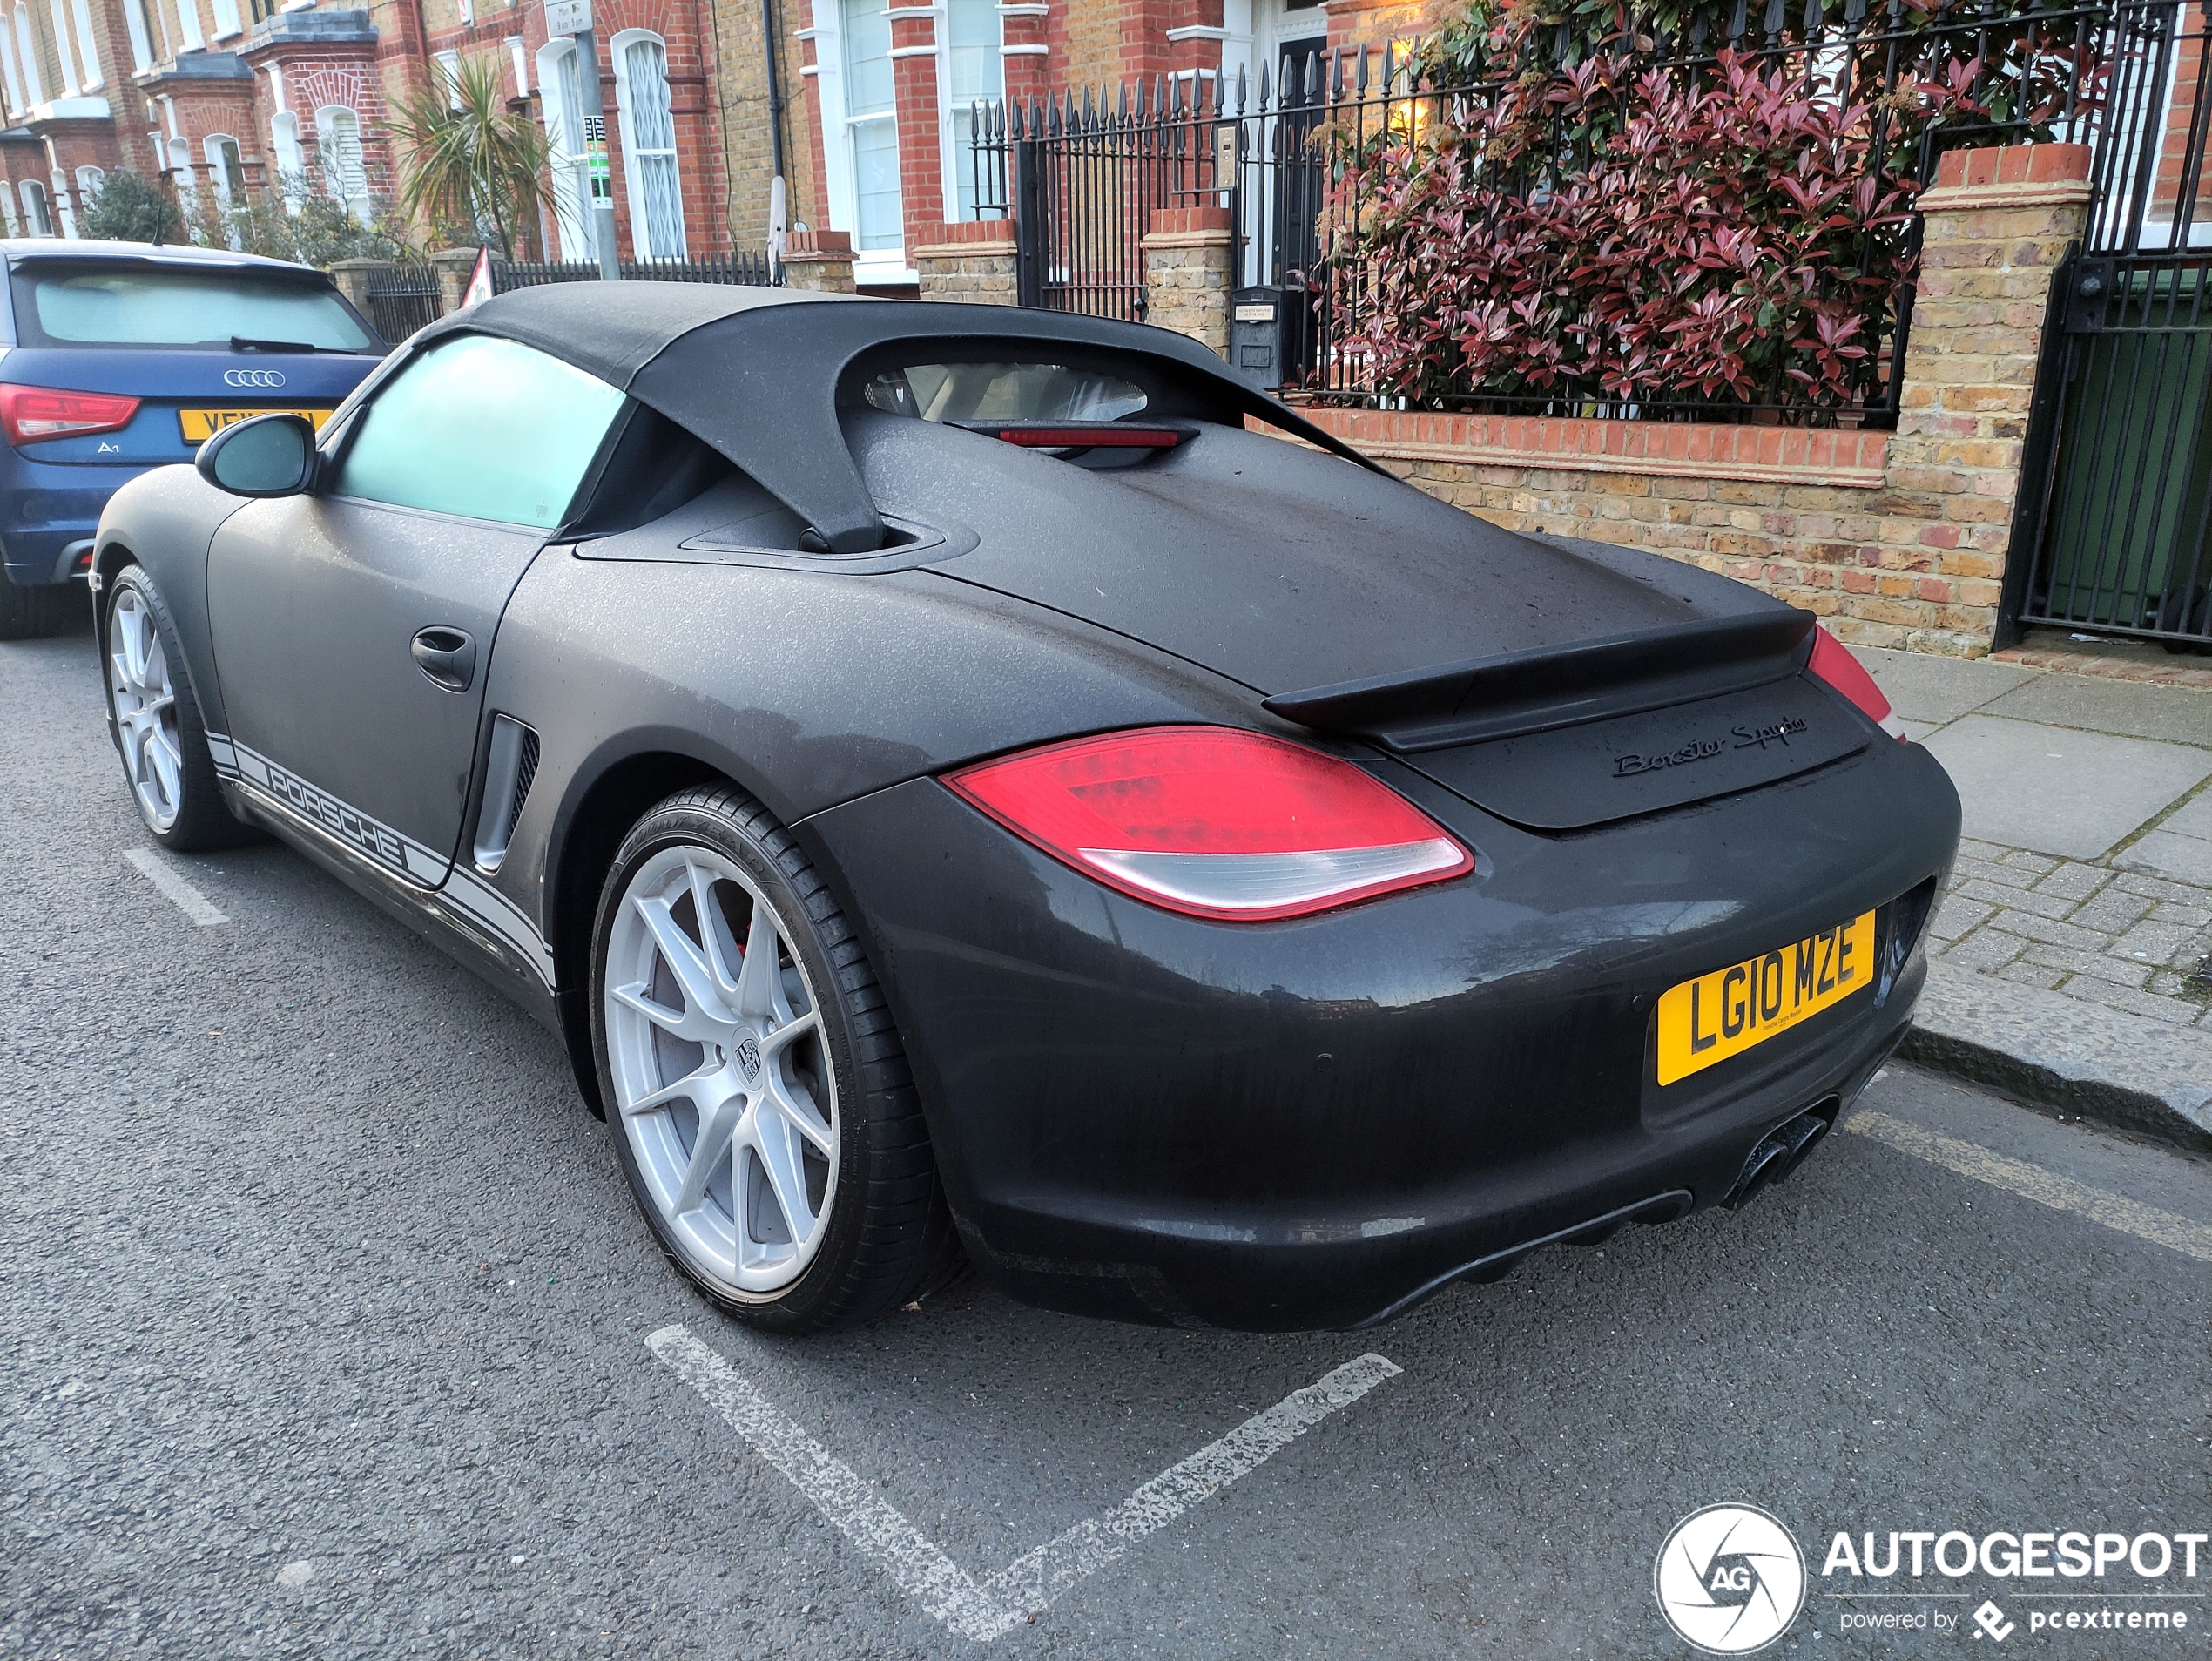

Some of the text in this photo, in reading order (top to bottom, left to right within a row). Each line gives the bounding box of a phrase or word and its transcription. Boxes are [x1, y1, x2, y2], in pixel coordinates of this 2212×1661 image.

[98, 442, 119, 454] A1
[1613, 716, 1807, 777] Boxster Spyder
[269, 767, 402, 866] PORSCHE
[1691, 919, 1856, 1055] LG10 MZE
